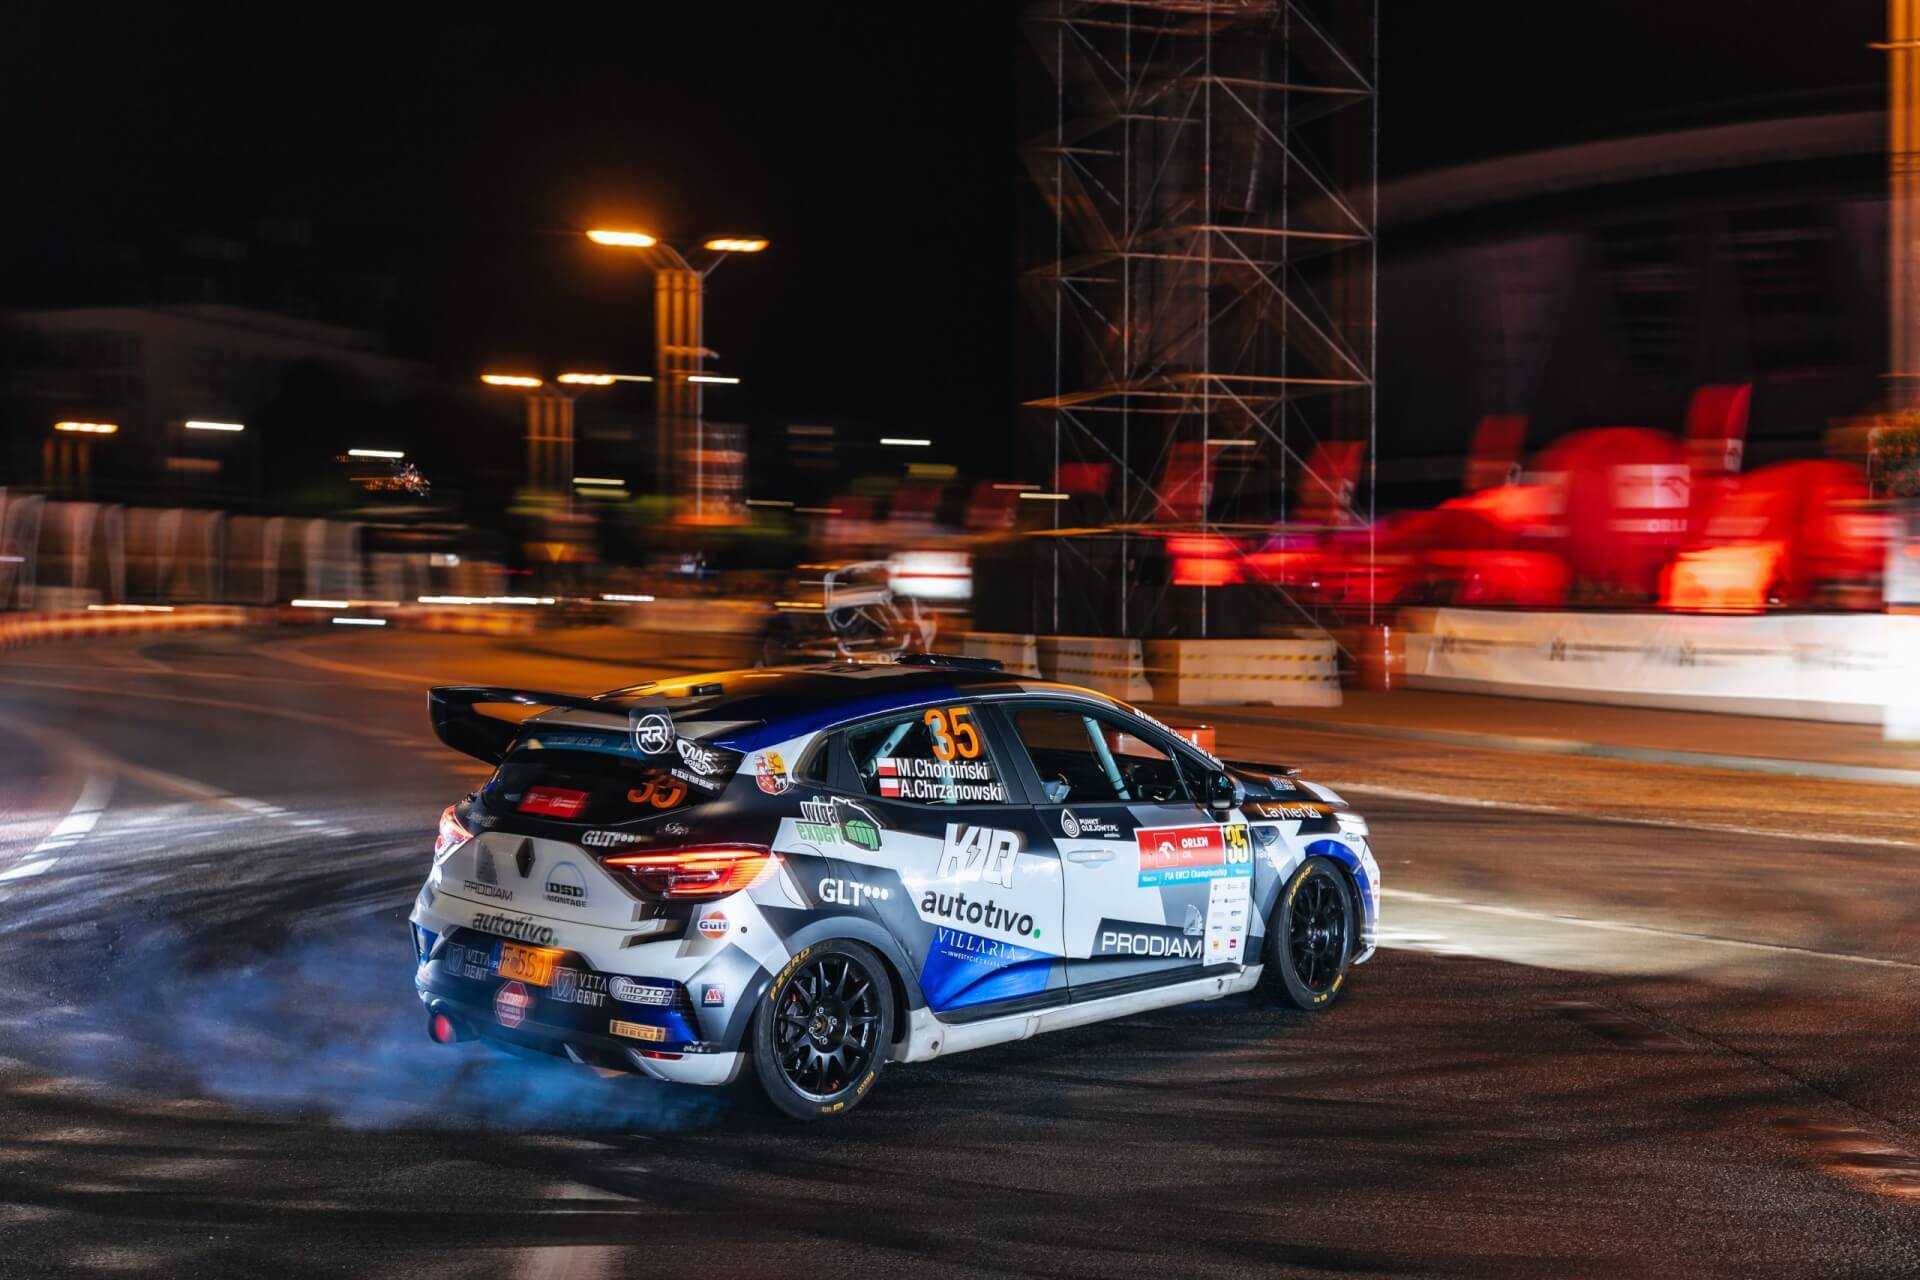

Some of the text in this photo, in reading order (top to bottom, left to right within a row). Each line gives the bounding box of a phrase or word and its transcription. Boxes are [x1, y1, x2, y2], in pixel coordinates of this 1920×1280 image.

[924, 706, 979, 761] 35
[896, 758, 988, 780] M.Chorbiński
[900, 779, 1003, 801] A.Chrzanowski
[1181, 837, 1209, 849] ORLEN
[1225, 823, 1249, 864] 35
[463, 880, 513, 901] PRODIAM
[546, 894, 587, 908] MONTAGE
[699, 921, 727, 930] Gulf
[938, 927, 1018, 961] VILLARIA
[1102, 932, 1202, 959] PRODIAM
[580, 974, 607, 992] VITA
